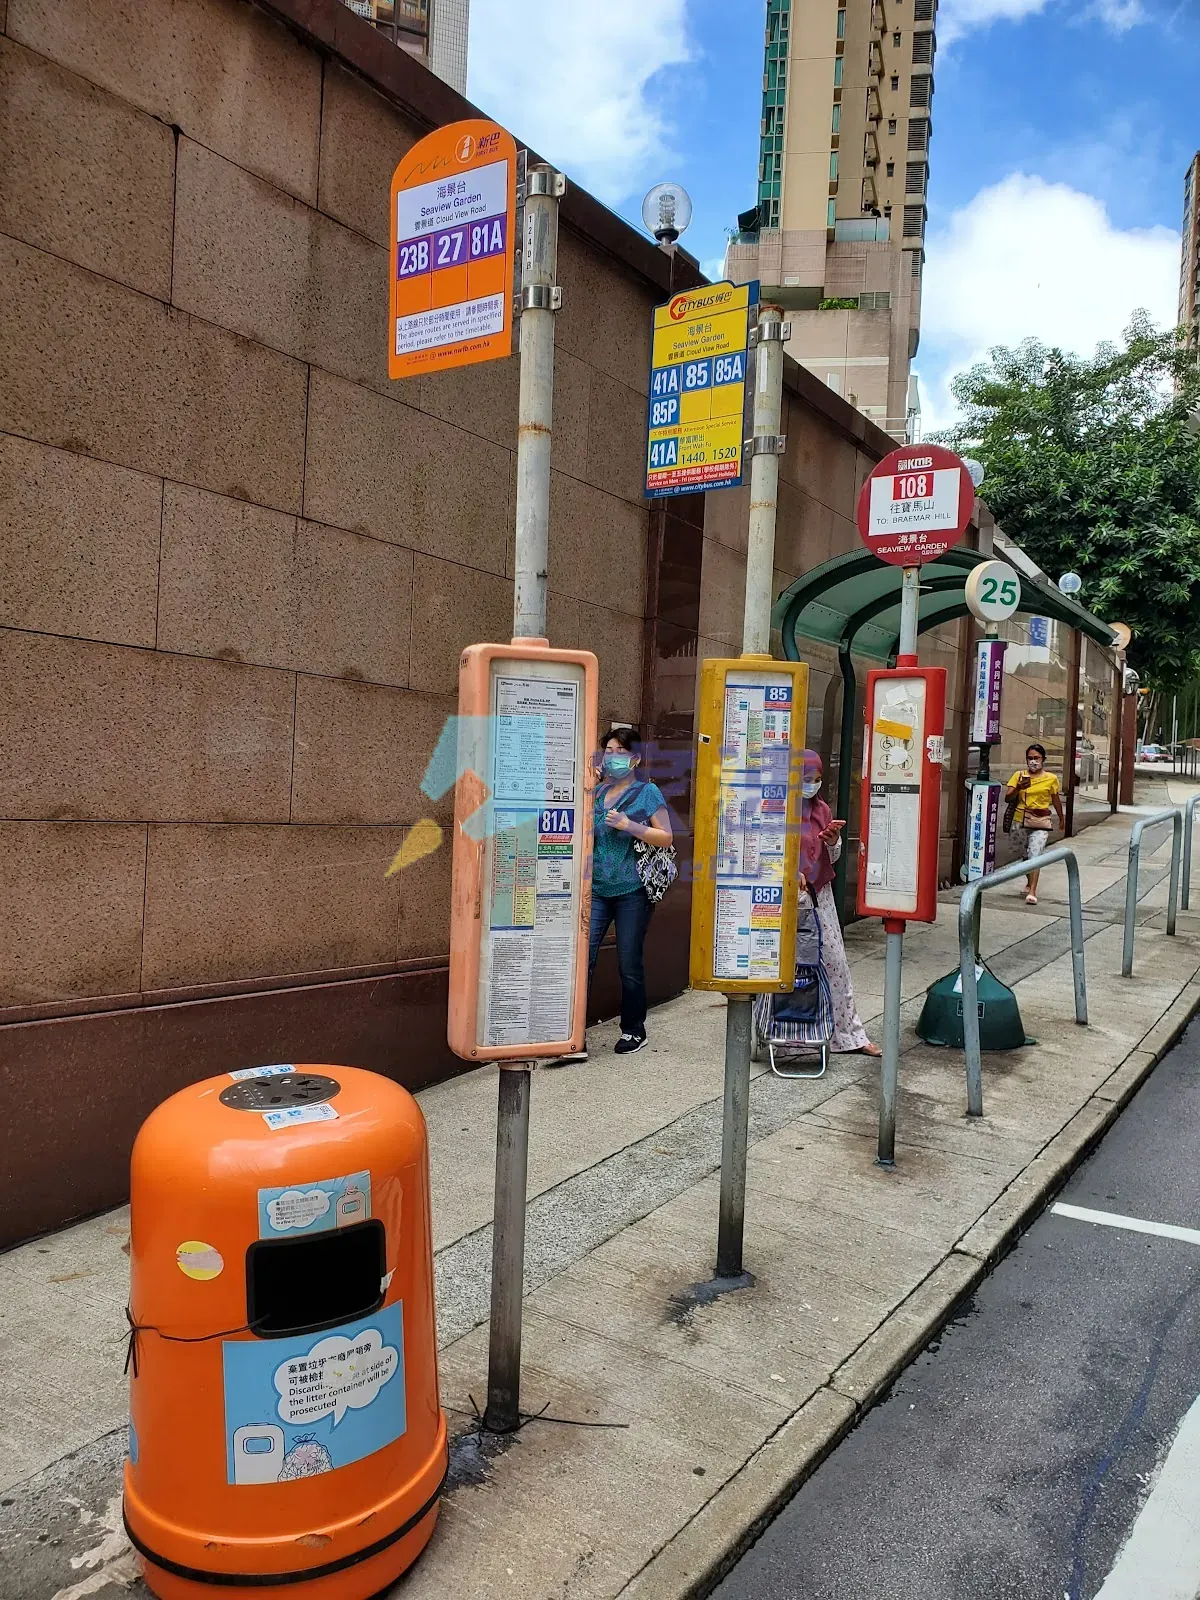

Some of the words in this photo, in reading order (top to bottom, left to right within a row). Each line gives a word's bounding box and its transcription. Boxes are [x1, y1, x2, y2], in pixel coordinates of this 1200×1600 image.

[478, 132, 501, 149] 新巴
[476, 149, 489, 157] FIRST
[489, 146, 499, 154] BUS
[437, 180, 466, 200] 海景台
[420, 202, 452, 217] Seaview
[453, 193, 482, 208] Garden
[436, 213, 453, 224] Cloud
[454, 210, 469, 220] View
[470, 204, 487, 215] Road
[400, 241, 429, 276] 23B
[437, 232, 464, 265] 27
[472, 219, 503, 256] 81A
[678, 295, 715, 313] CITYBUS
[398, 333, 407, 341] The
[408, 330, 423, 338] above
[424, 325, 442, 335] routes
[442, 322, 451, 330] are
[452, 317, 469, 329] served
[470, 316, 476, 324] in
[477, 310, 502, 324] specified
[687, 322, 713, 336] 海景台
[416, 336, 433, 347] please
[433, 332, 447, 343] refer
[447, 331, 454, 339] to
[454, 328, 464, 337] the
[673, 339, 700, 350] Seaview
[701, 333, 725, 344] Garden
[437, 341, 490, 358] www.nwfb.com.hk
[686, 347, 702, 357] Cloud
[716, 341, 730, 350] Road
[654, 370, 678, 399] 41A
[686, 361, 708, 387] 85
[716, 354, 743, 382] 85A
[653, 398, 677, 426] 85P
[705, 422, 720, 431] Special
[721, 419, 737, 428] Service
[651, 440, 677, 466] 41A
[681, 452, 708, 464] 1440,
[712, 446, 737, 460] 1520
[907, 457, 933, 469] KMB
[648, 479, 663, 487] Service
[681, 479, 732, 492] www.citybus.com.hk
[899, 475, 927, 499] 108
[889, 500, 935, 514] 往寶馬山
[876, 517, 889, 525] TO:
[892, 513, 931, 524] BRAEMAR
[898, 533, 928, 544] 海景台
[877, 545, 911, 554] SEAVIEW
[915, 542, 948, 551] GARDEN
[980, 577, 1017, 606] 25
[769, 687, 788, 701] 85
[763, 785, 785, 798] 85A
[542, 810, 570, 832] 81A
[755, 887, 780, 903] 85P
[370, 1360, 384, 1373] side
[385, 1354, 392, 1365] of
[289, 1396, 304, 1407] the
[306, 1392, 326, 1405] litter
[328, 1379, 366, 1397] container
[367, 1371, 381, 1385] will
[381, 1366, 390, 1378] be
[289, 1398, 337, 1419] prosecuted
